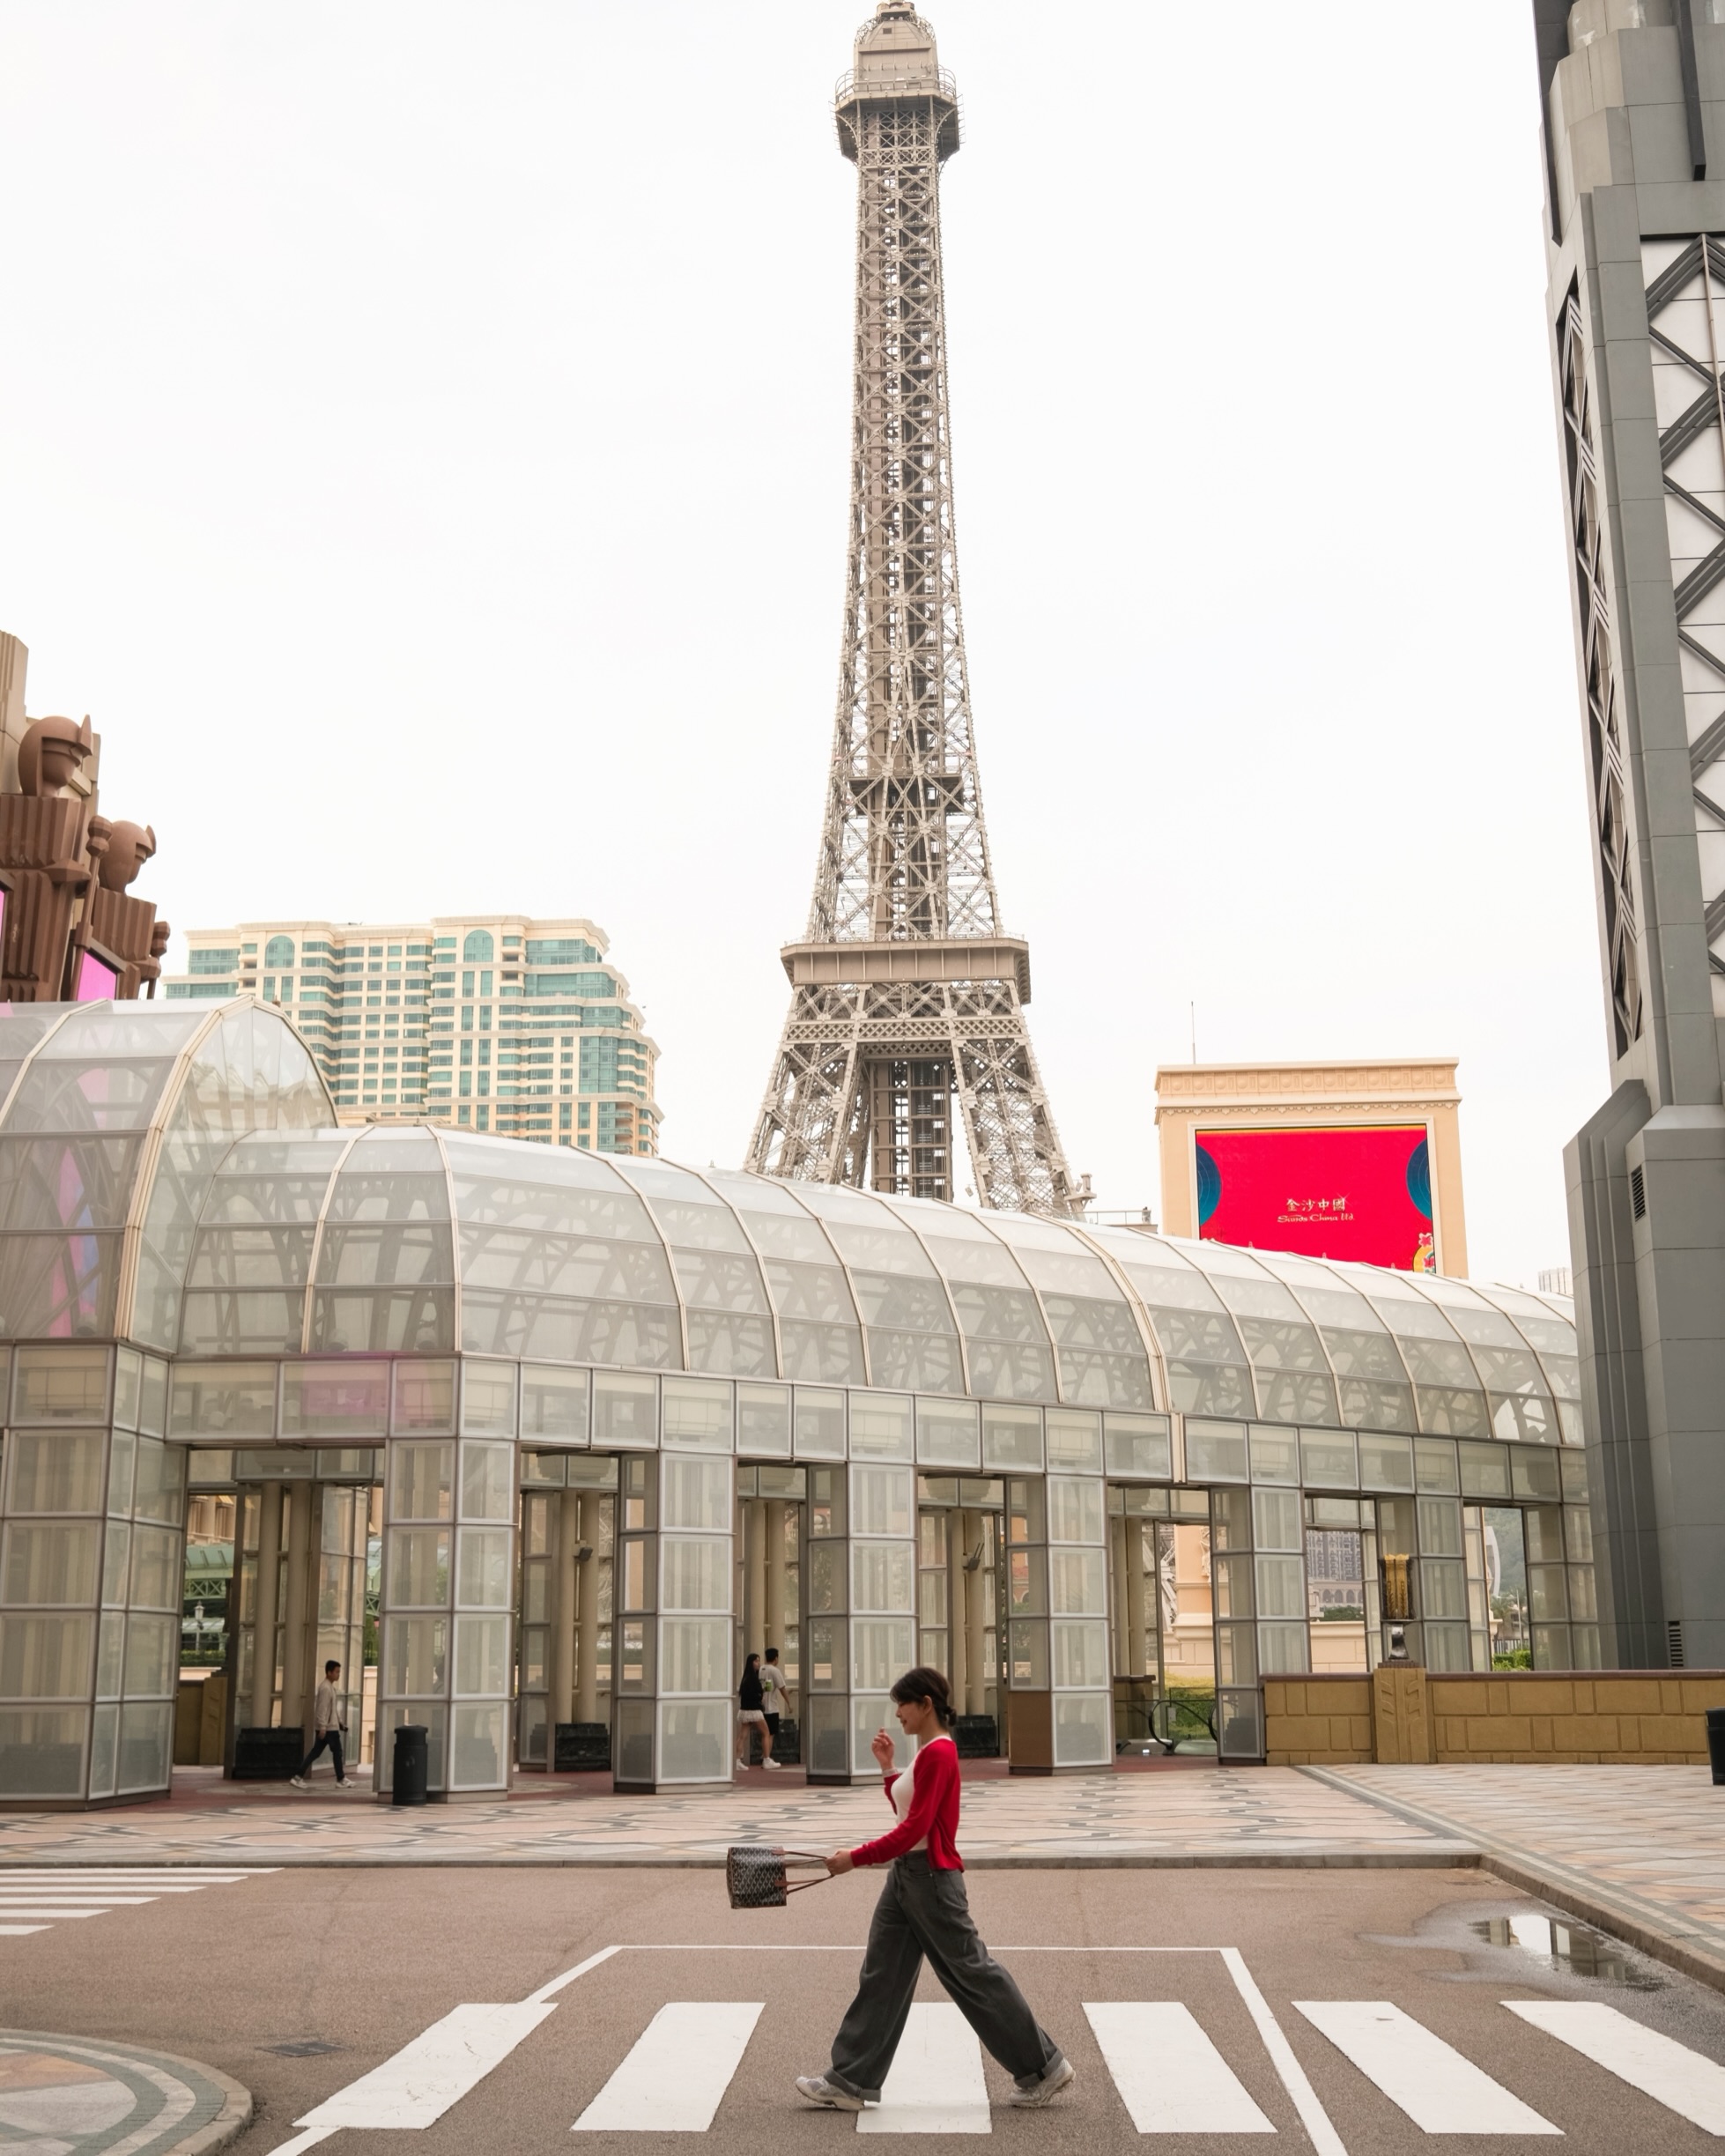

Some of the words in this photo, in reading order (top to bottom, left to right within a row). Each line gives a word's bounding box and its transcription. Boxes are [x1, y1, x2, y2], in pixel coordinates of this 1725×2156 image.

[1287, 1198, 1345, 1211] 金沙中國
[1277, 1214, 1308, 1223] Sands
[1309, 1213, 1338, 1222] China
